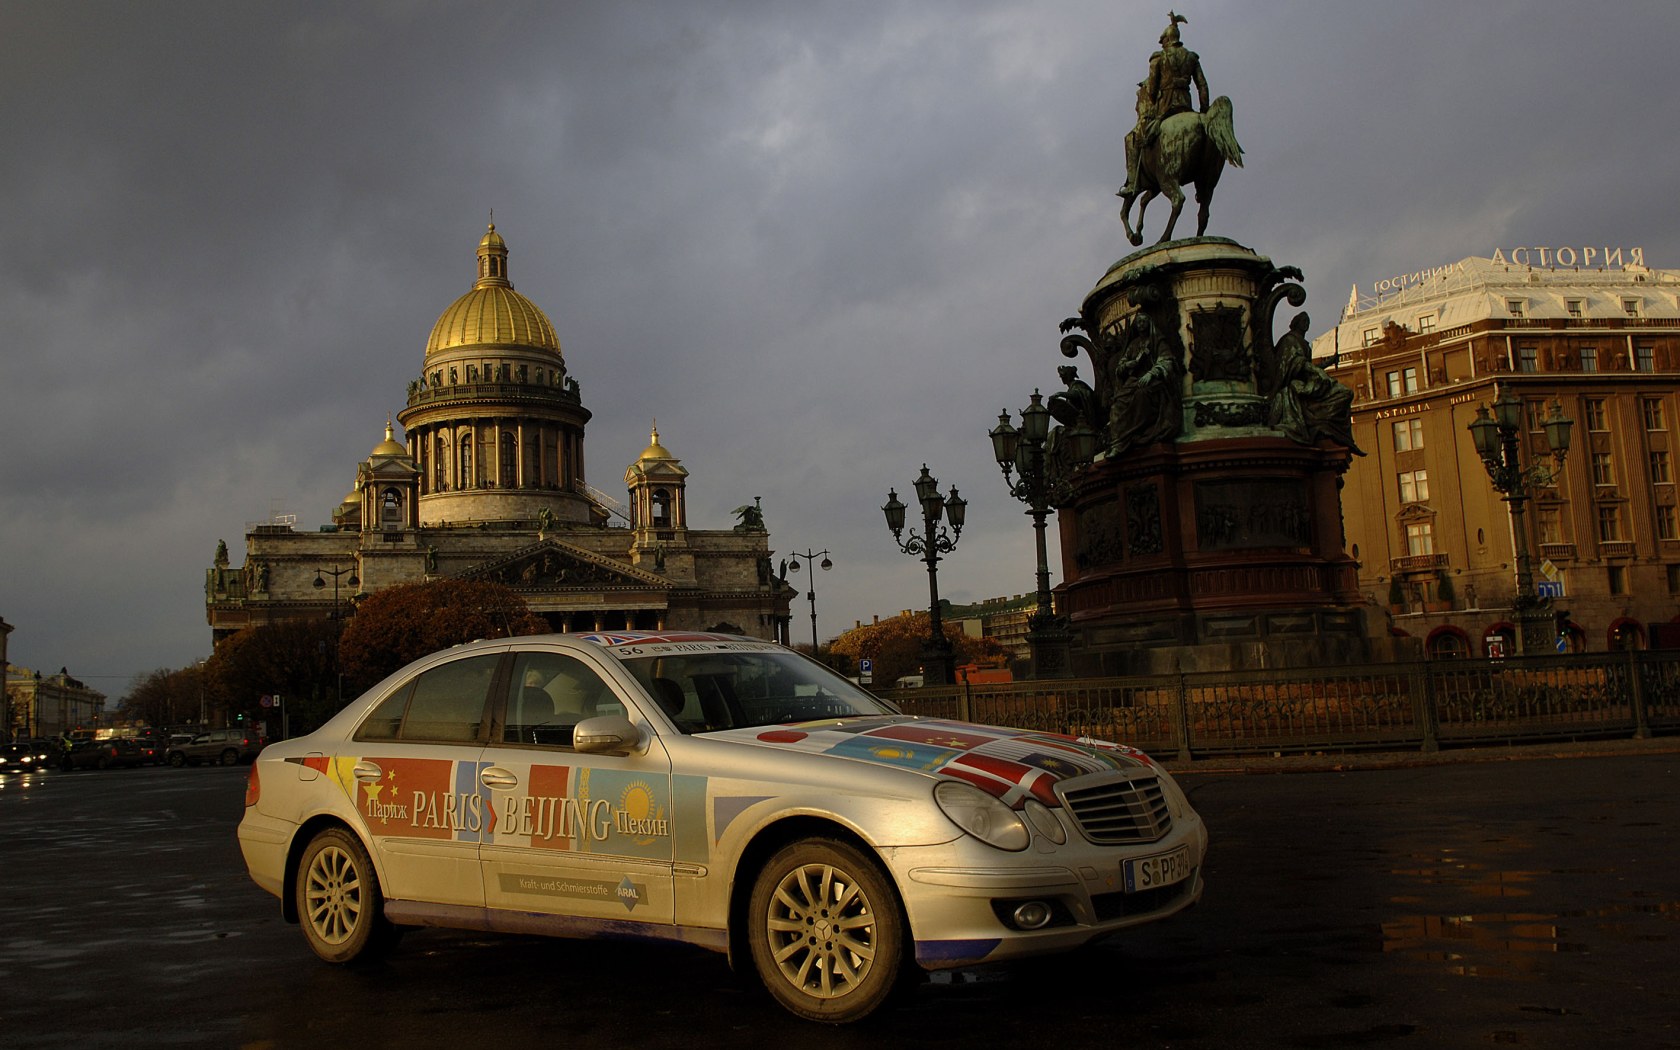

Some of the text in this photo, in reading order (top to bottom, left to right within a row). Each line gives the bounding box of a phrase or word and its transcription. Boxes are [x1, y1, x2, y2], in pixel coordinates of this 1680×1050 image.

[1490, 246, 1645, 267] АСТОРИЯ
[1374, 261, 1464, 293] ГОСТИНИЦА
[1375, 402, 1431, 420] ASTORIA
[619, 646, 644, 656] 56
[675, 644, 711, 652] PARIS
[862, 660, 870, 671] P
[367, 797, 408, 825] Париж
[411, 790, 612, 841] PARIS BEIJING
[616, 809, 669, 837] Пекин
[519, 878, 608, 896] Kraft- und Schmierstoffe
[617, 887, 639, 899] ARAL
